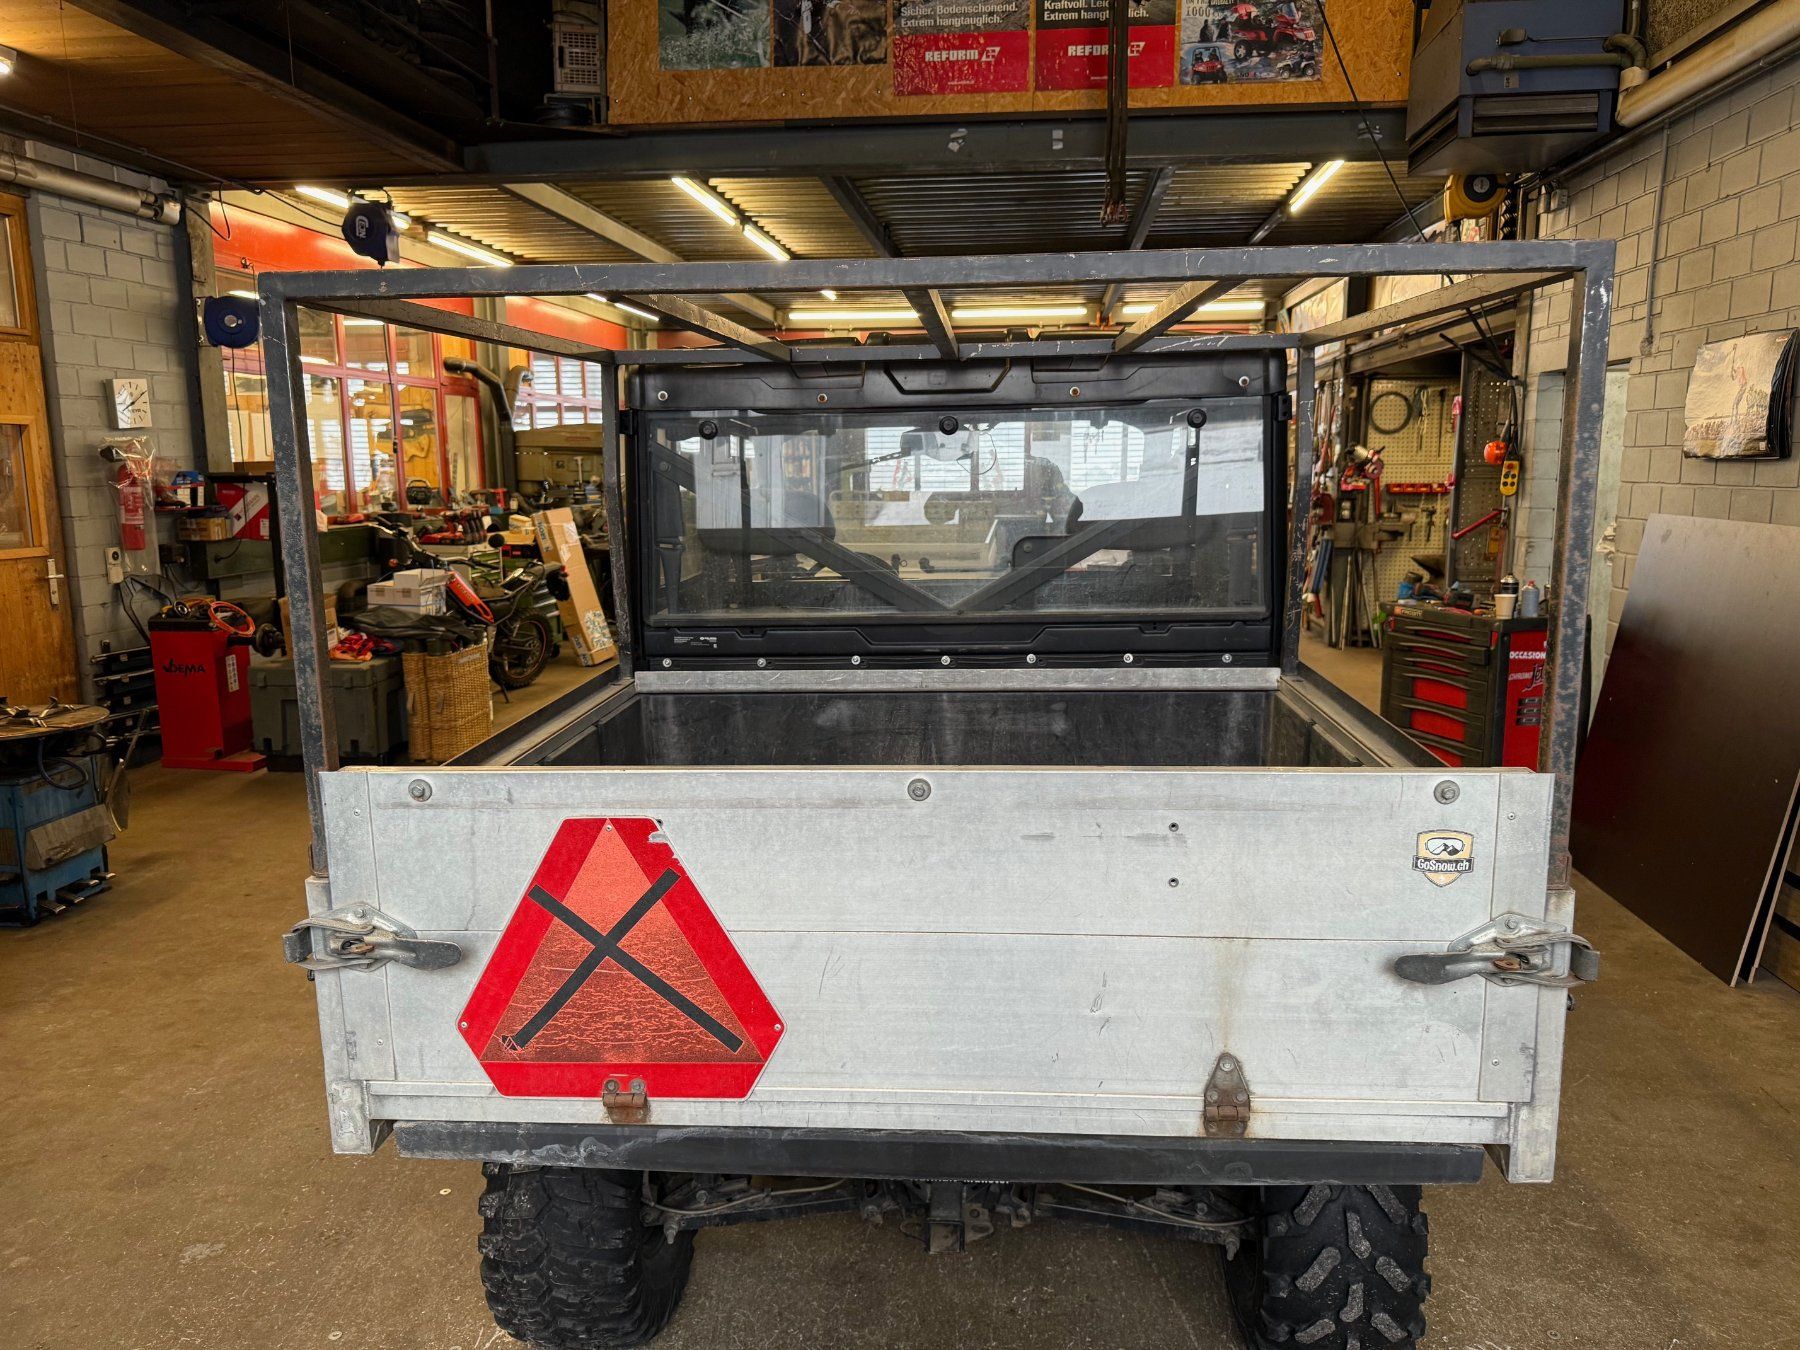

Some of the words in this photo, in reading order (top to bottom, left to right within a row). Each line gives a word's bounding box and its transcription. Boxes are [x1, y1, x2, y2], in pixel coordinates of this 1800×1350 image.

[901, 6, 934, 16] Sicher.
[936, 2, 1018, 15] Bodenschonend.
[1044, 0, 1088, 10] Kraftvoll.
[1044, 11, 1078, 21] Extrem
[1186, 6, 1211, 17] 1000
[901, 18, 934, 28] Extrem
[925, 49, 979, 62] REFORM
[1068, 44, 1109, 56] REFOR
[1417, 858, 1469, 871] GoSnow.ch
